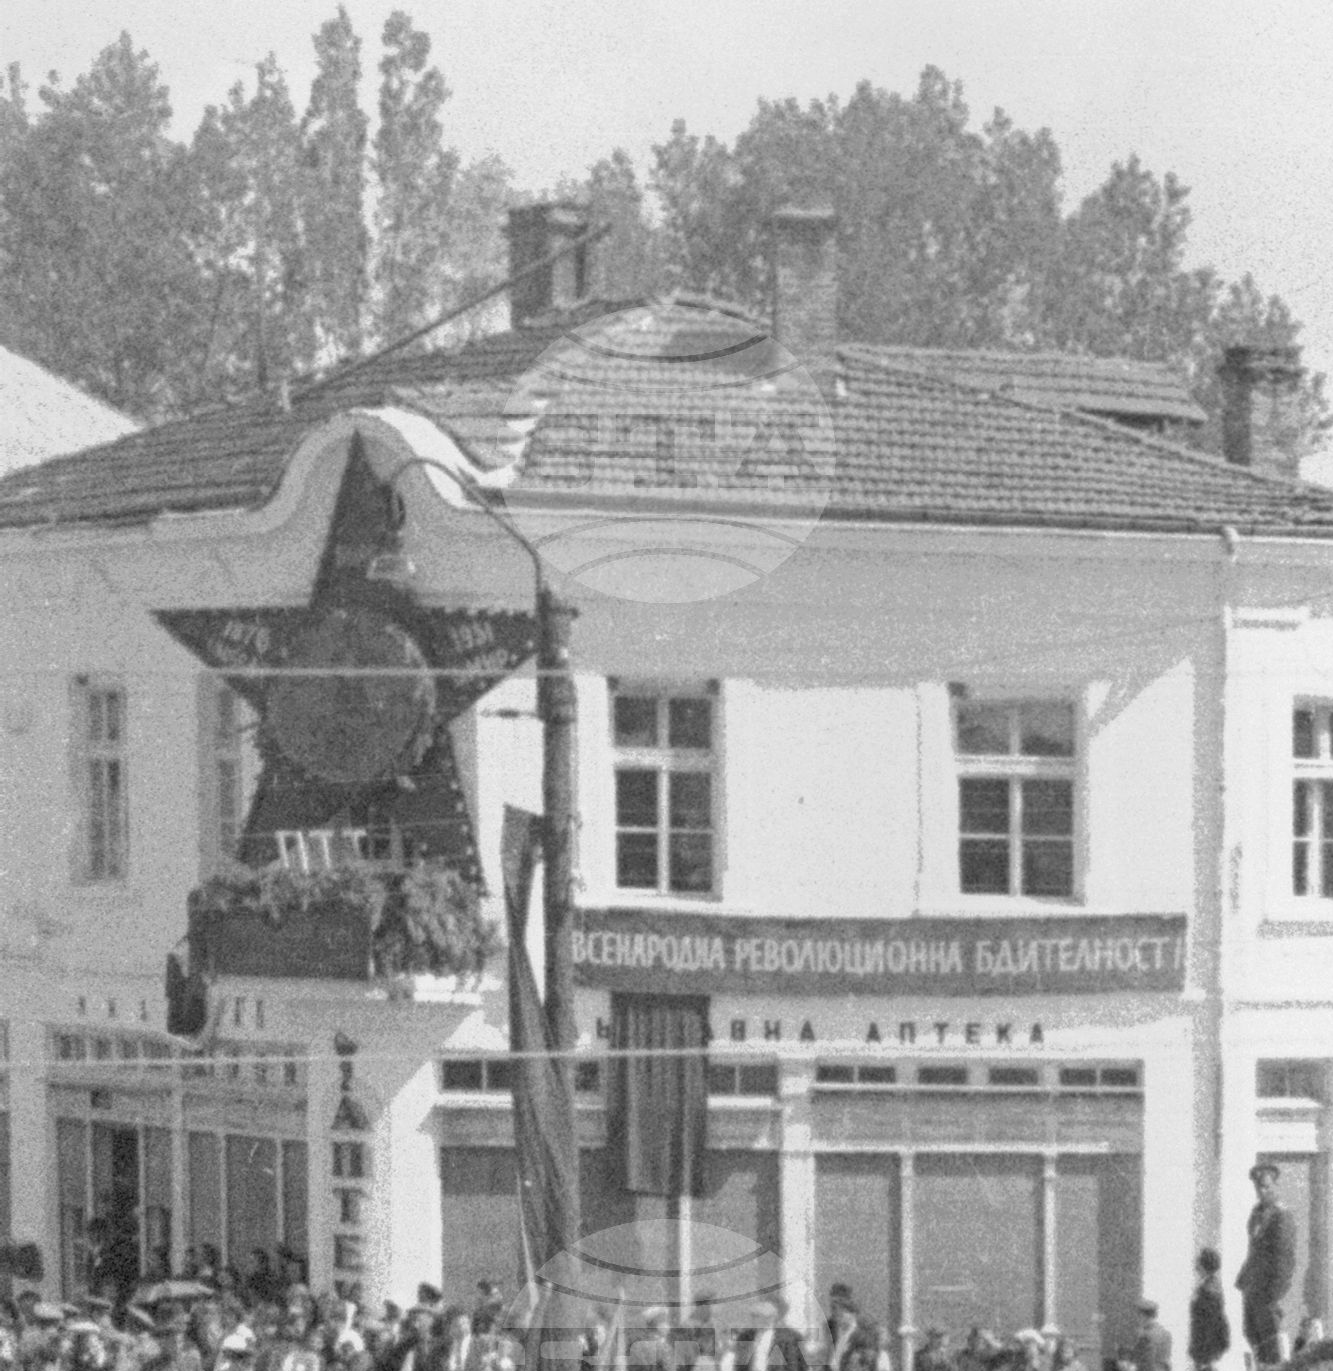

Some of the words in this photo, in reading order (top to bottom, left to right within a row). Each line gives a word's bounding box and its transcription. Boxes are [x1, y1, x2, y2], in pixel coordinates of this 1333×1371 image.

[571, 929, 726, 973] ВСЕНАРОДНА
[734, 936, 963, 977] РЕВОЛЮЦИОННА
[866, 1021, 1045, 1045] АПТЕКА
